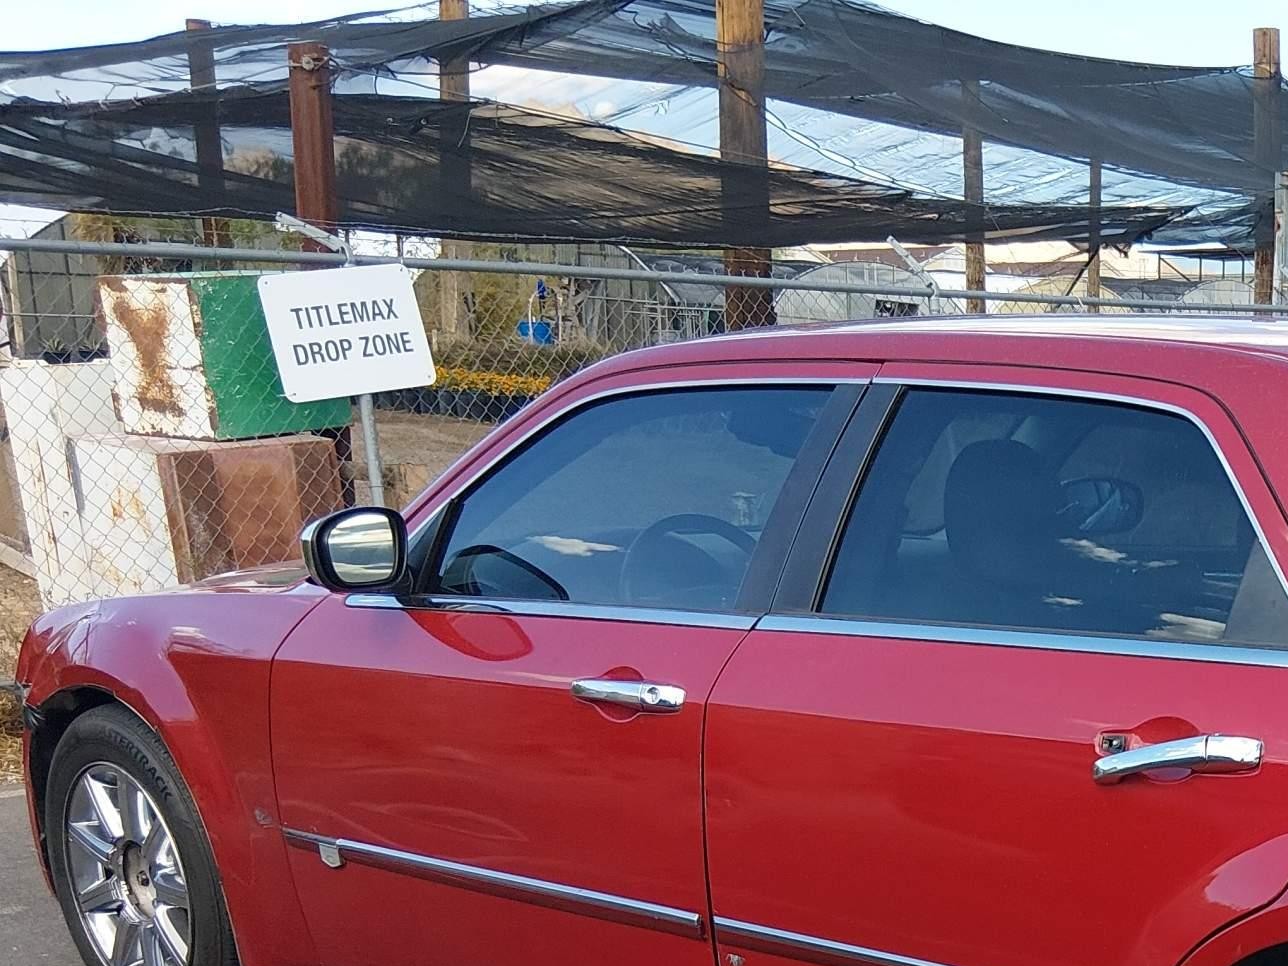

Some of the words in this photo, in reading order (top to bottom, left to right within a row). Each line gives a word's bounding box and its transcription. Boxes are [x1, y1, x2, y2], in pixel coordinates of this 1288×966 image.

[290, 298, 399, 330] TITLEMAX
[292, 338, 353, 366] DROP
[358, 331, 414, 358] ZONE
